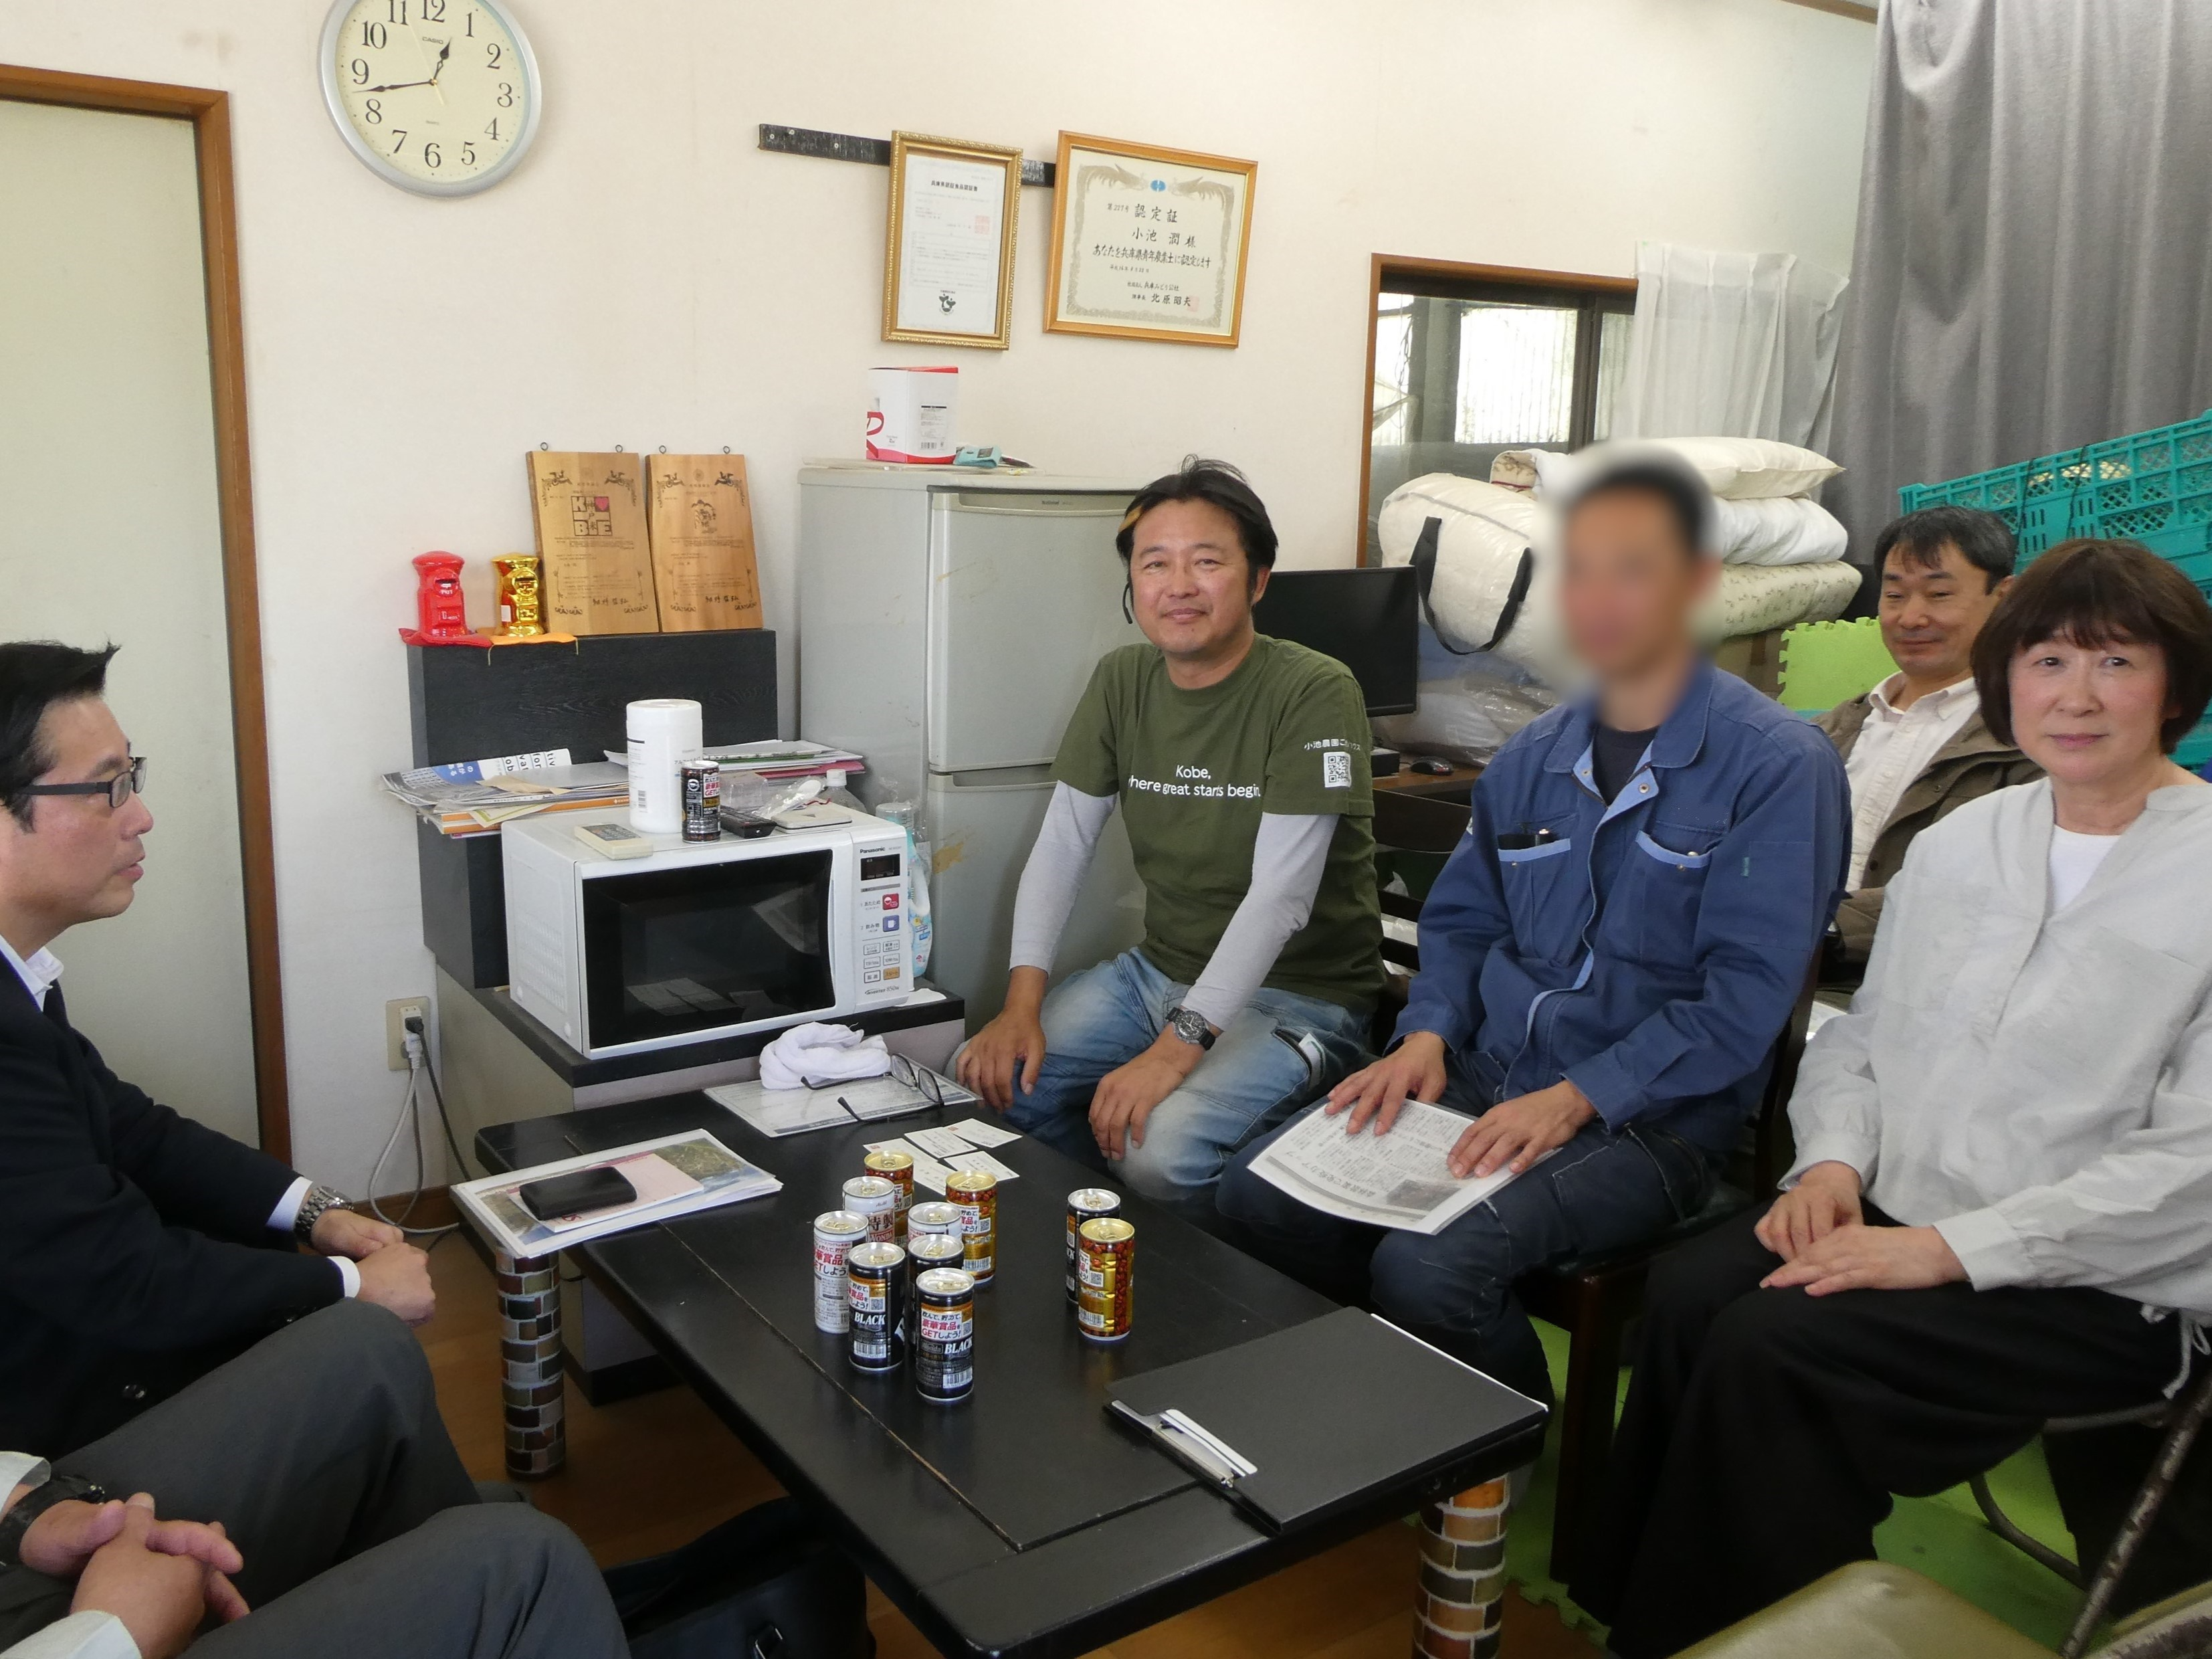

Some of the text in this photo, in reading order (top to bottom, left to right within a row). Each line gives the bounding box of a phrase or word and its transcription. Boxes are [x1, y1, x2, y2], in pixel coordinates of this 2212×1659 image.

[361, 20, 387, 49] 10
[465, 12, 475, 38] 1
[487, 43, 501, 70] 2
[352, 59, 369, 84] 9
[497, 82, 513, 108] 3
[365, 99, 382, 124] 8
[484, 117, 500, 140] 4
[392, 129, 407, 154] 7
[461, 141, 476, 165] 5
[424, 142, 441, 168] 6
[1135, 203, 1177, 223] 認定証
[1175, 765, 1211, 780] Kobe,
[1128, 775, 1161, 792] here
[1163, 783, 1191, 795] great
[854, 1310, 886, 1325] BLACK
[922, 1328, 961, 1339] GETしよう!
[944, 1336, 973, 1355] BLACK
